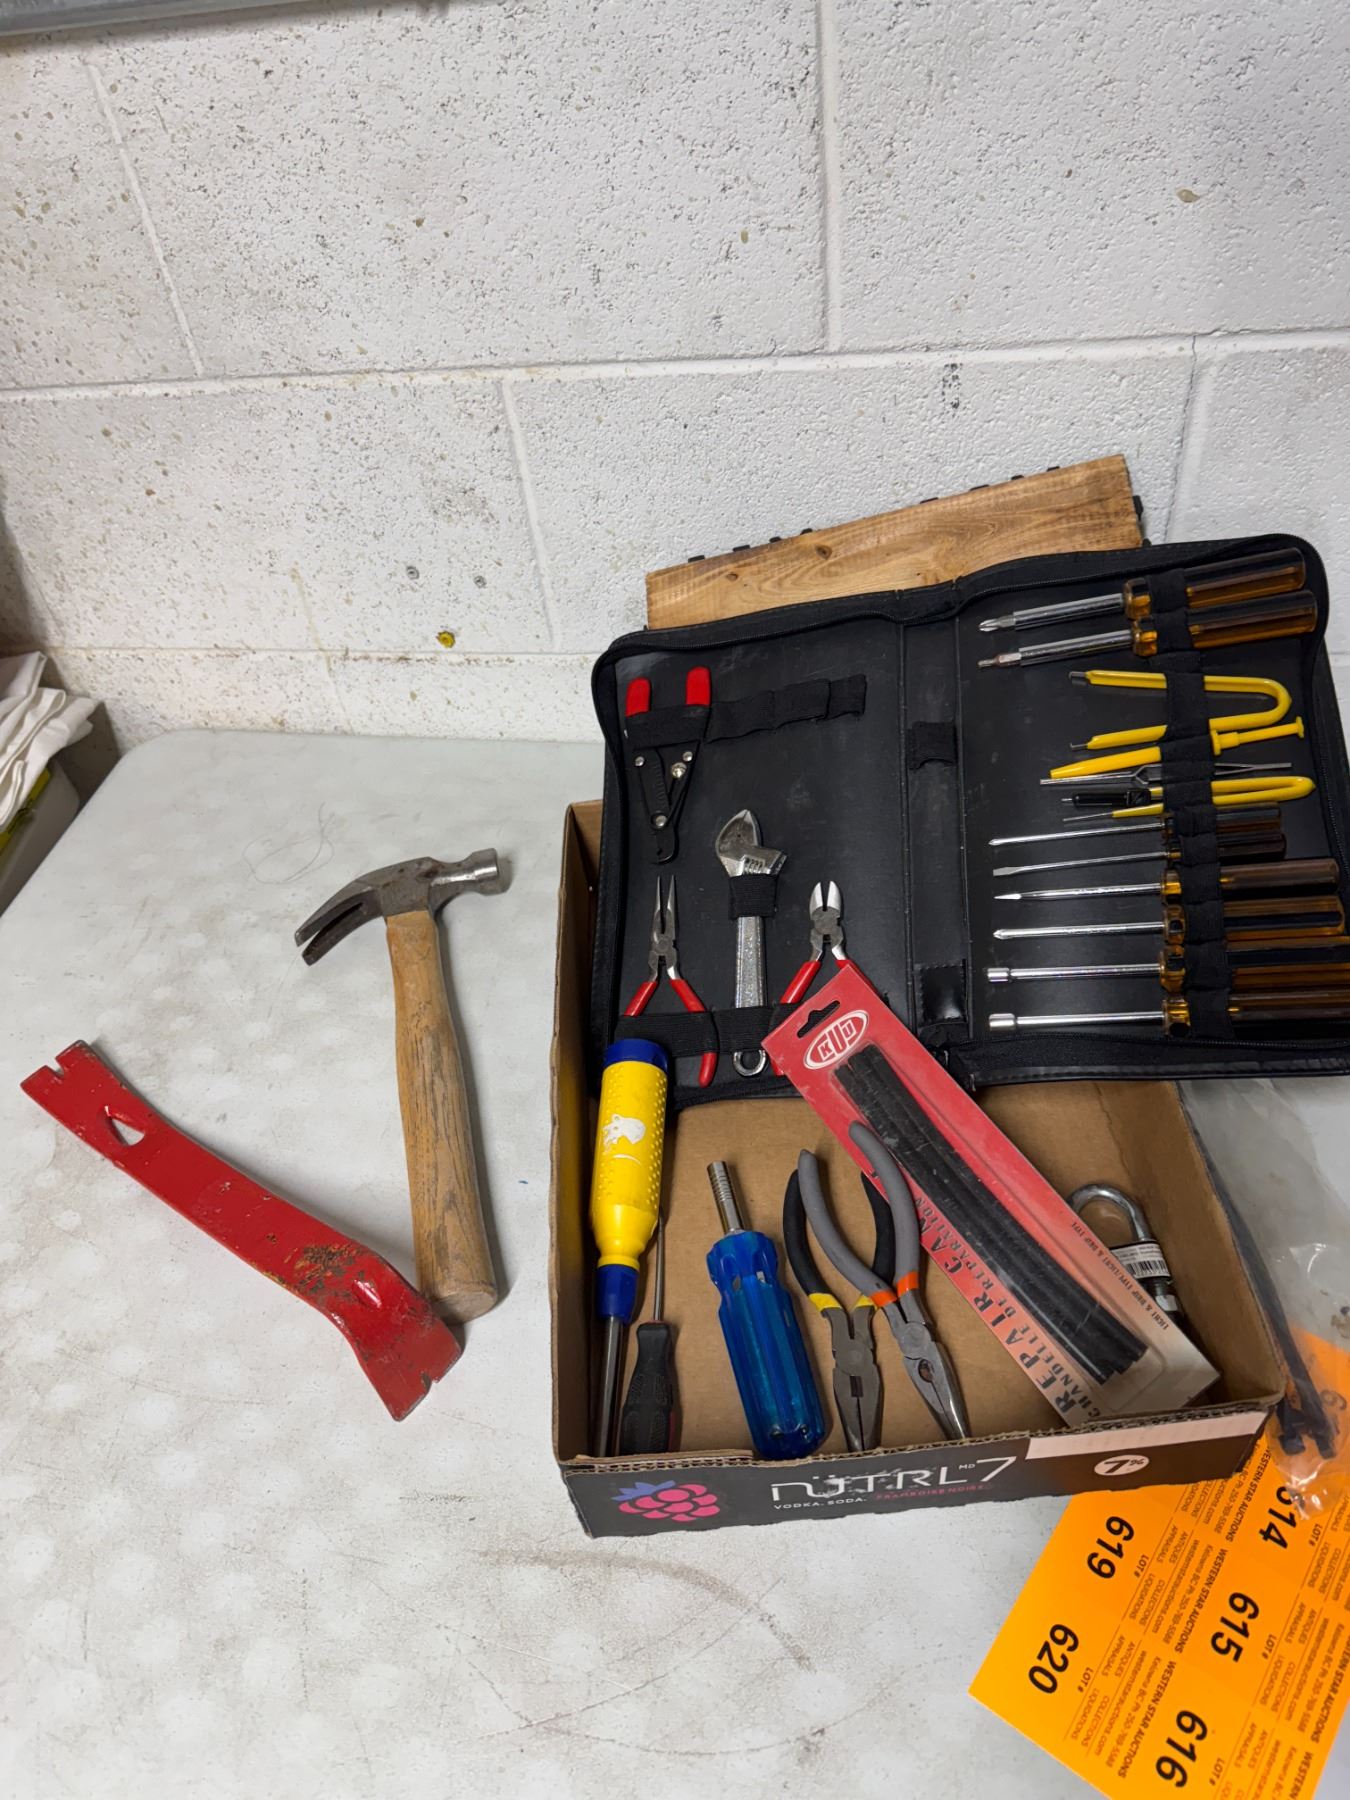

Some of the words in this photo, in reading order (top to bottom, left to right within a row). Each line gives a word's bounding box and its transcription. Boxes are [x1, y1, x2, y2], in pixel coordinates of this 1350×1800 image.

[997, 1297, 1016, 1317] DE
[970, 1290, 1078, 1413] REPAIR
[1017, 1322, 1101, 1419] CHANDELLE
[1242, 1481, 1258, 1502] STAR
[1224, 1501, 1249, 1542] AUCTIONS
[1309, 1523, 1323, 1541] LOT
[1087, 1516, 1134, 1579] 619
[1135, 1554, 1149, 1572] LOT
[1203, 1547, 1228, 1587] WESTERN
[1194, 1586, 1210, 1609] STAR
[1174, 1608, 1200, 1652] AUCTIONS
[1211, 1592, 1259, 1663] 615
[1262, 1633, 1276, 1653] LOT
[1028, 1624, 1079, 1694] 620
[1079, 1666, 1094, 1686] LOT
[1076, 1684, 1084, 1692] #
[1149, 1660, 1177, 1704] WESTERN
[1328, 1670, 1345, 1694] STAR
[1138, 1704, 1156, 1729] STAR
[1309, 1693, 1336, 1743] AUCTIONS
[1115, 1728, 1146, 1779] AUCTIONS
[1156, 1710, 1208, 1788] 616
[1210, 1757, 1226, 1779] LOT
[1287, 1751, 1314, 1800] WESTERN
